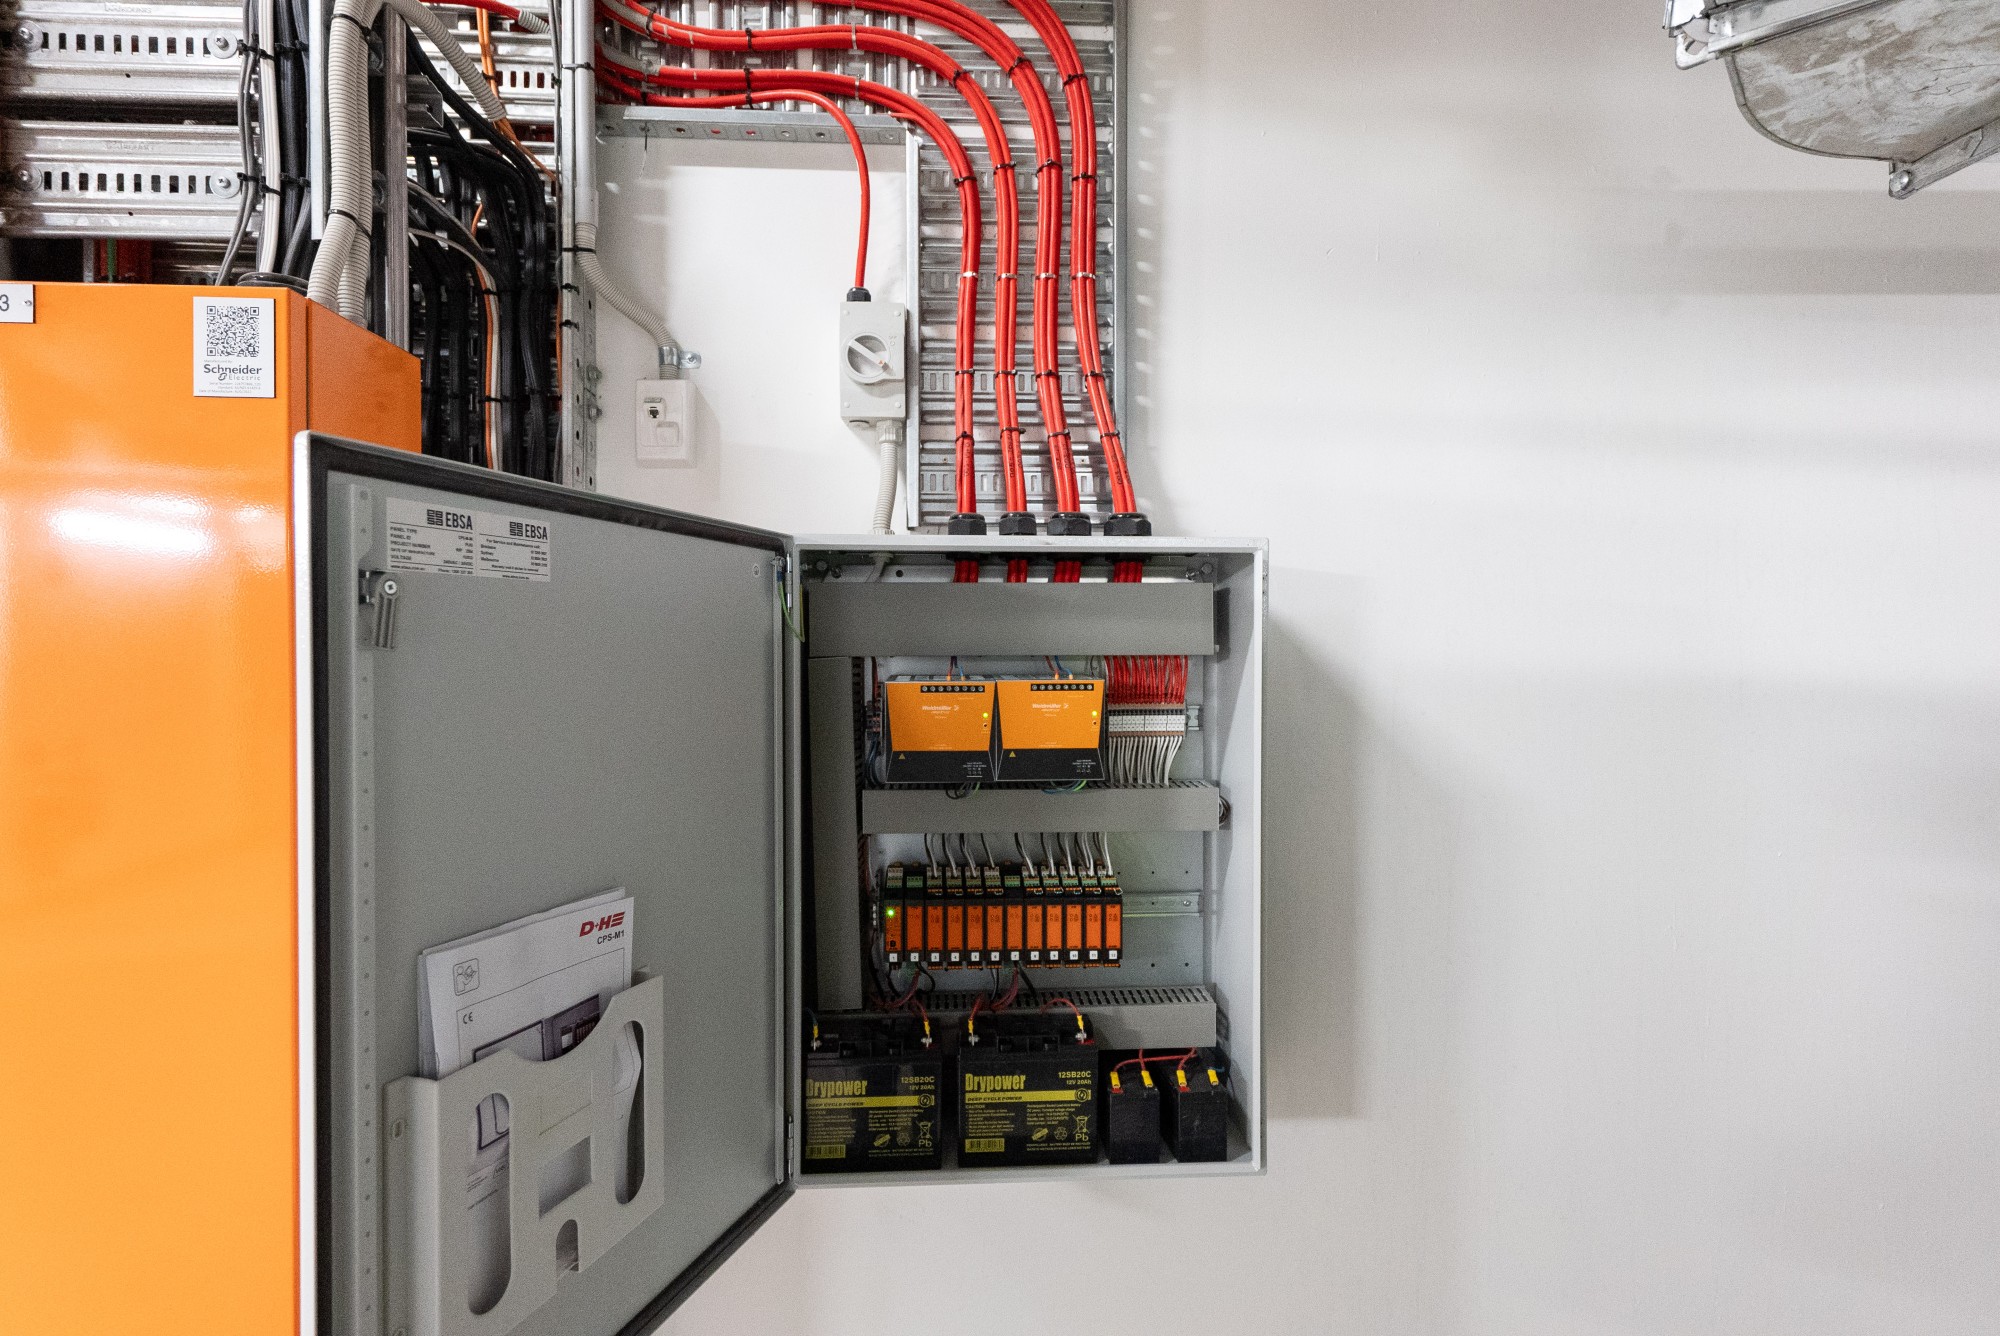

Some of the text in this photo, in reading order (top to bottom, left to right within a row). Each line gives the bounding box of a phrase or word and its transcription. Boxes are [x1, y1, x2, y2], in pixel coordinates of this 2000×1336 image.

[0, 294, 9, 312] 3
[203, 363, 262, 375] Schneider
[228, 373, 261, 381] Electric
[445, 512, 473, 530] EBSA
[525, 523, 548, 540] EBSA
[597, 929, 624, 944] CPS-M1
[806, 1078, 868, 1098] Drypower
[901, 1076, 935, 1084] 12SB20C
[965, 1073, 1026, 1092] Drypower
[918, 1139, 932, 1148] Pb
